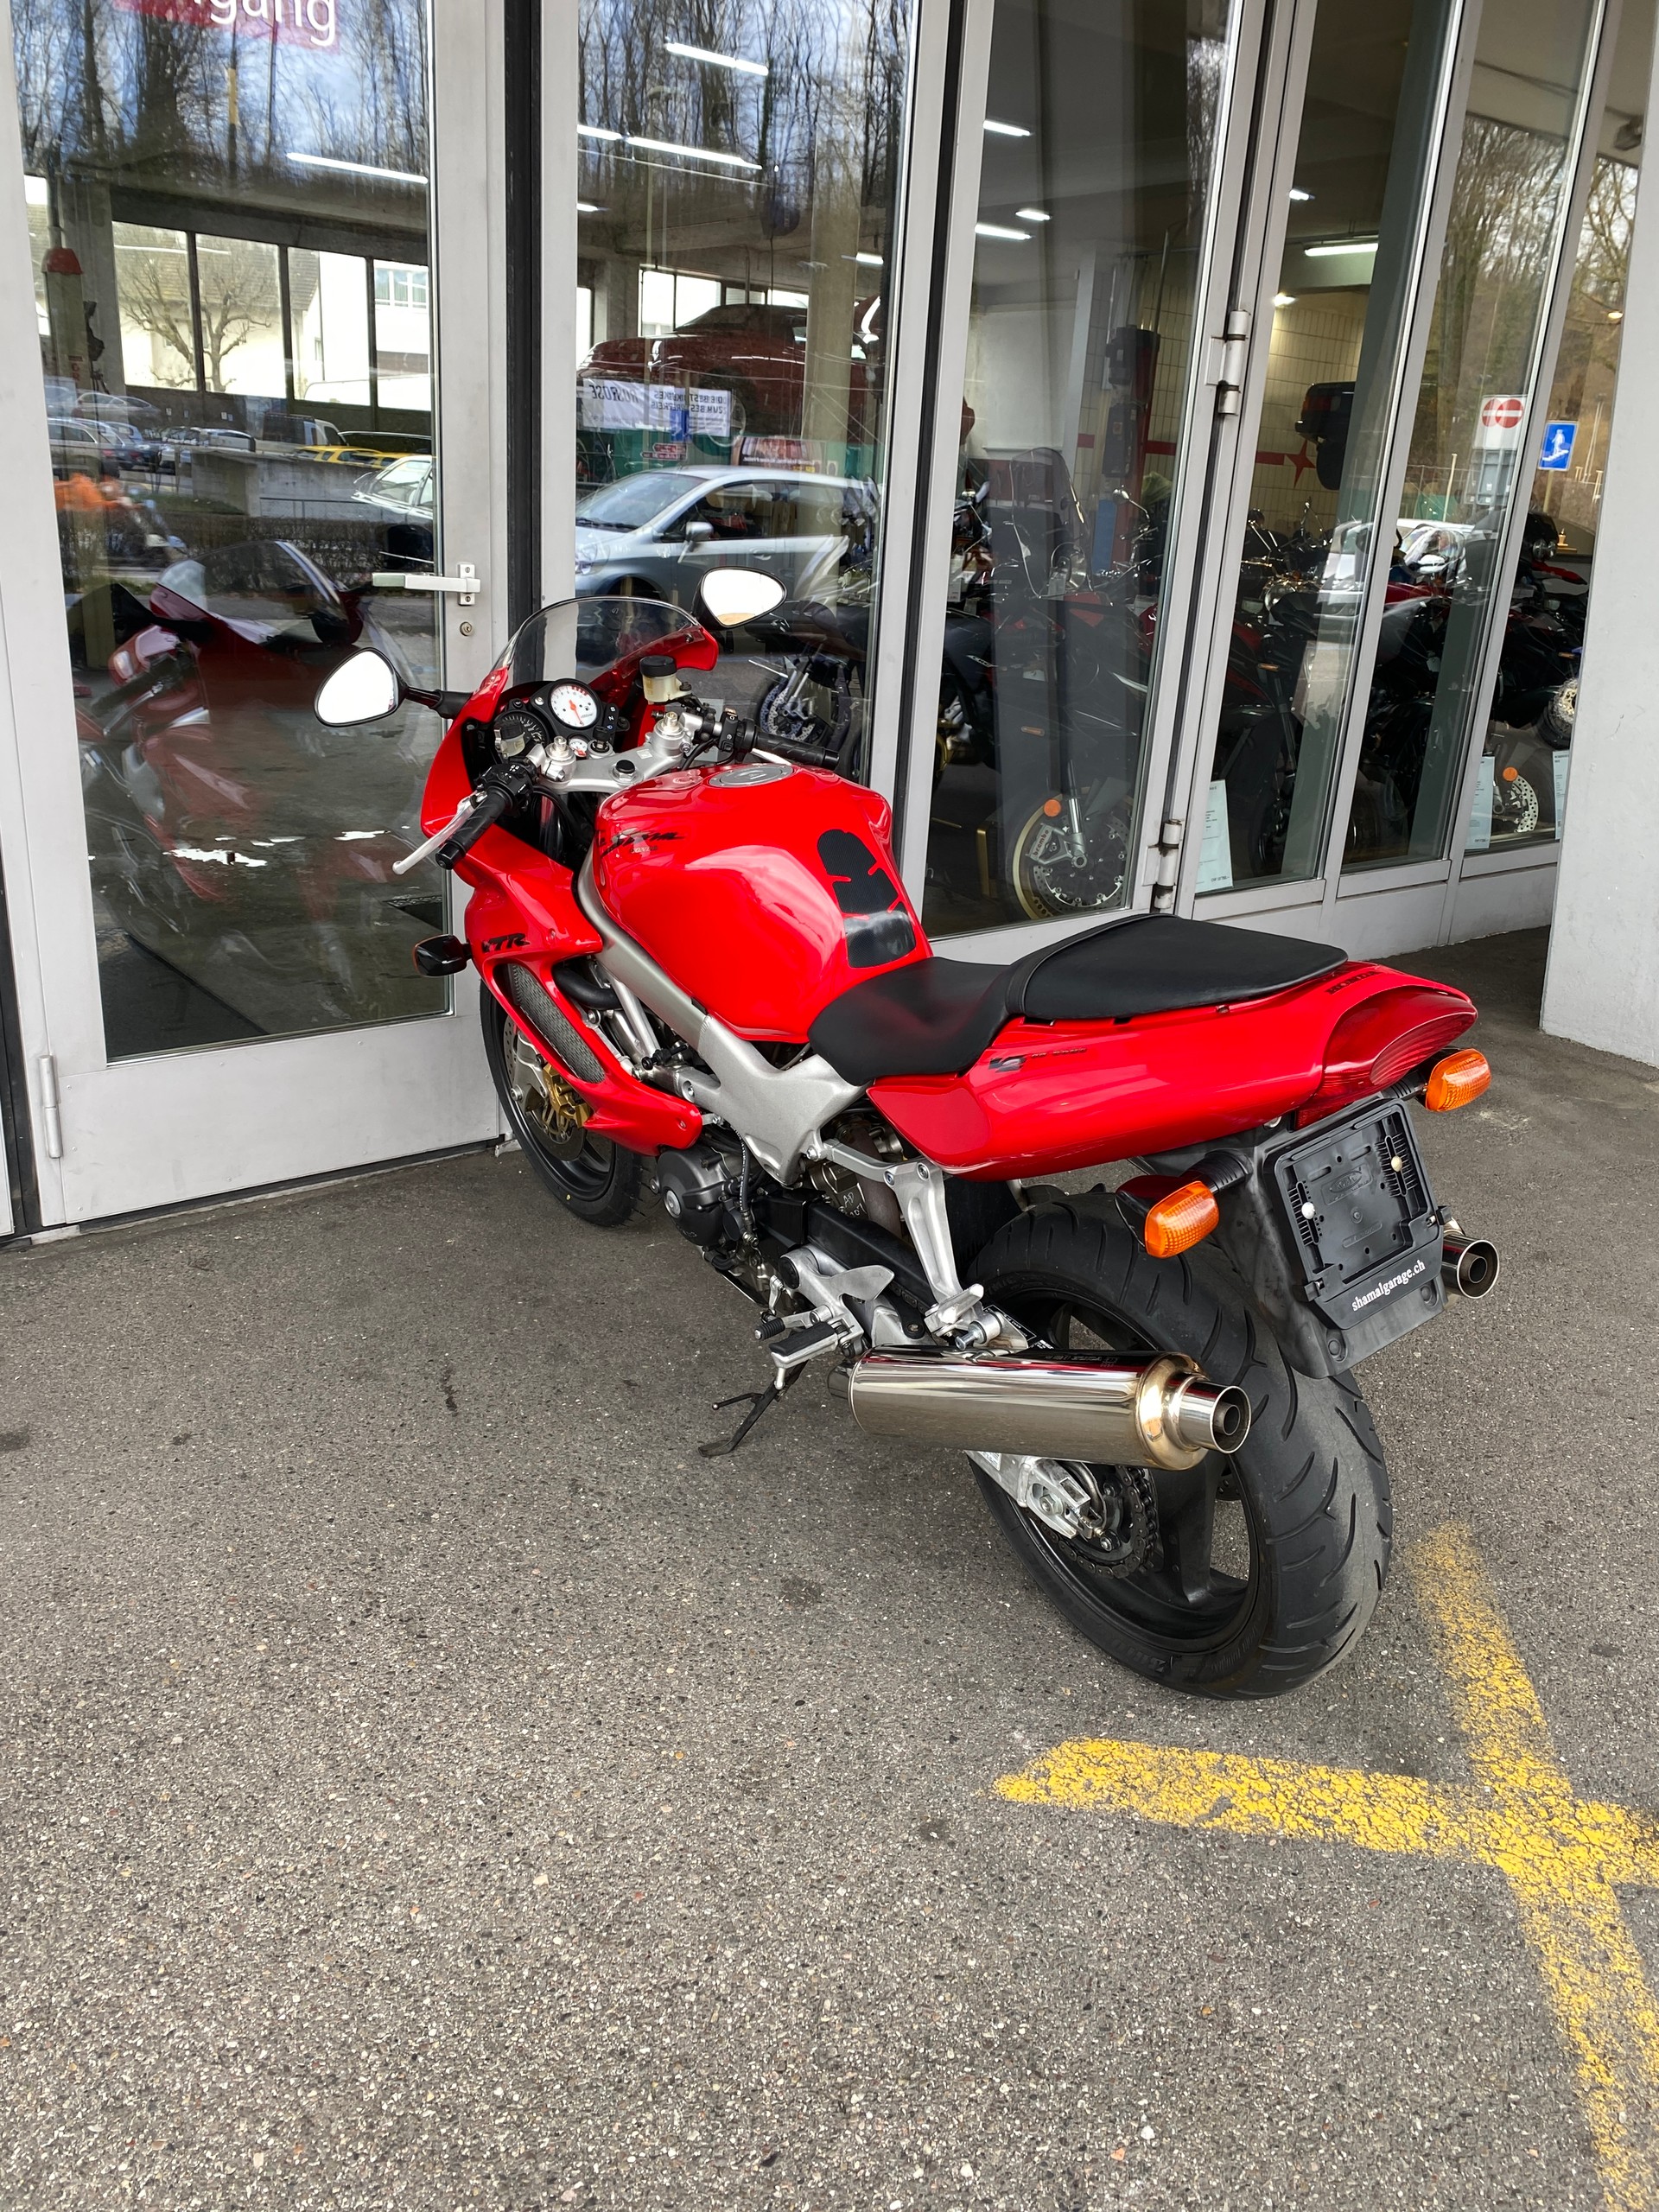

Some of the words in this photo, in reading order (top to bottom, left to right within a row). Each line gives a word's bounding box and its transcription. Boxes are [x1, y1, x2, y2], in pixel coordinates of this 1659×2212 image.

[192, 0, 335, 47] gang
[1033, 830, 1049, 855] brembo
[1351, 1259, 1426, 1312] shamalgarage.ch
